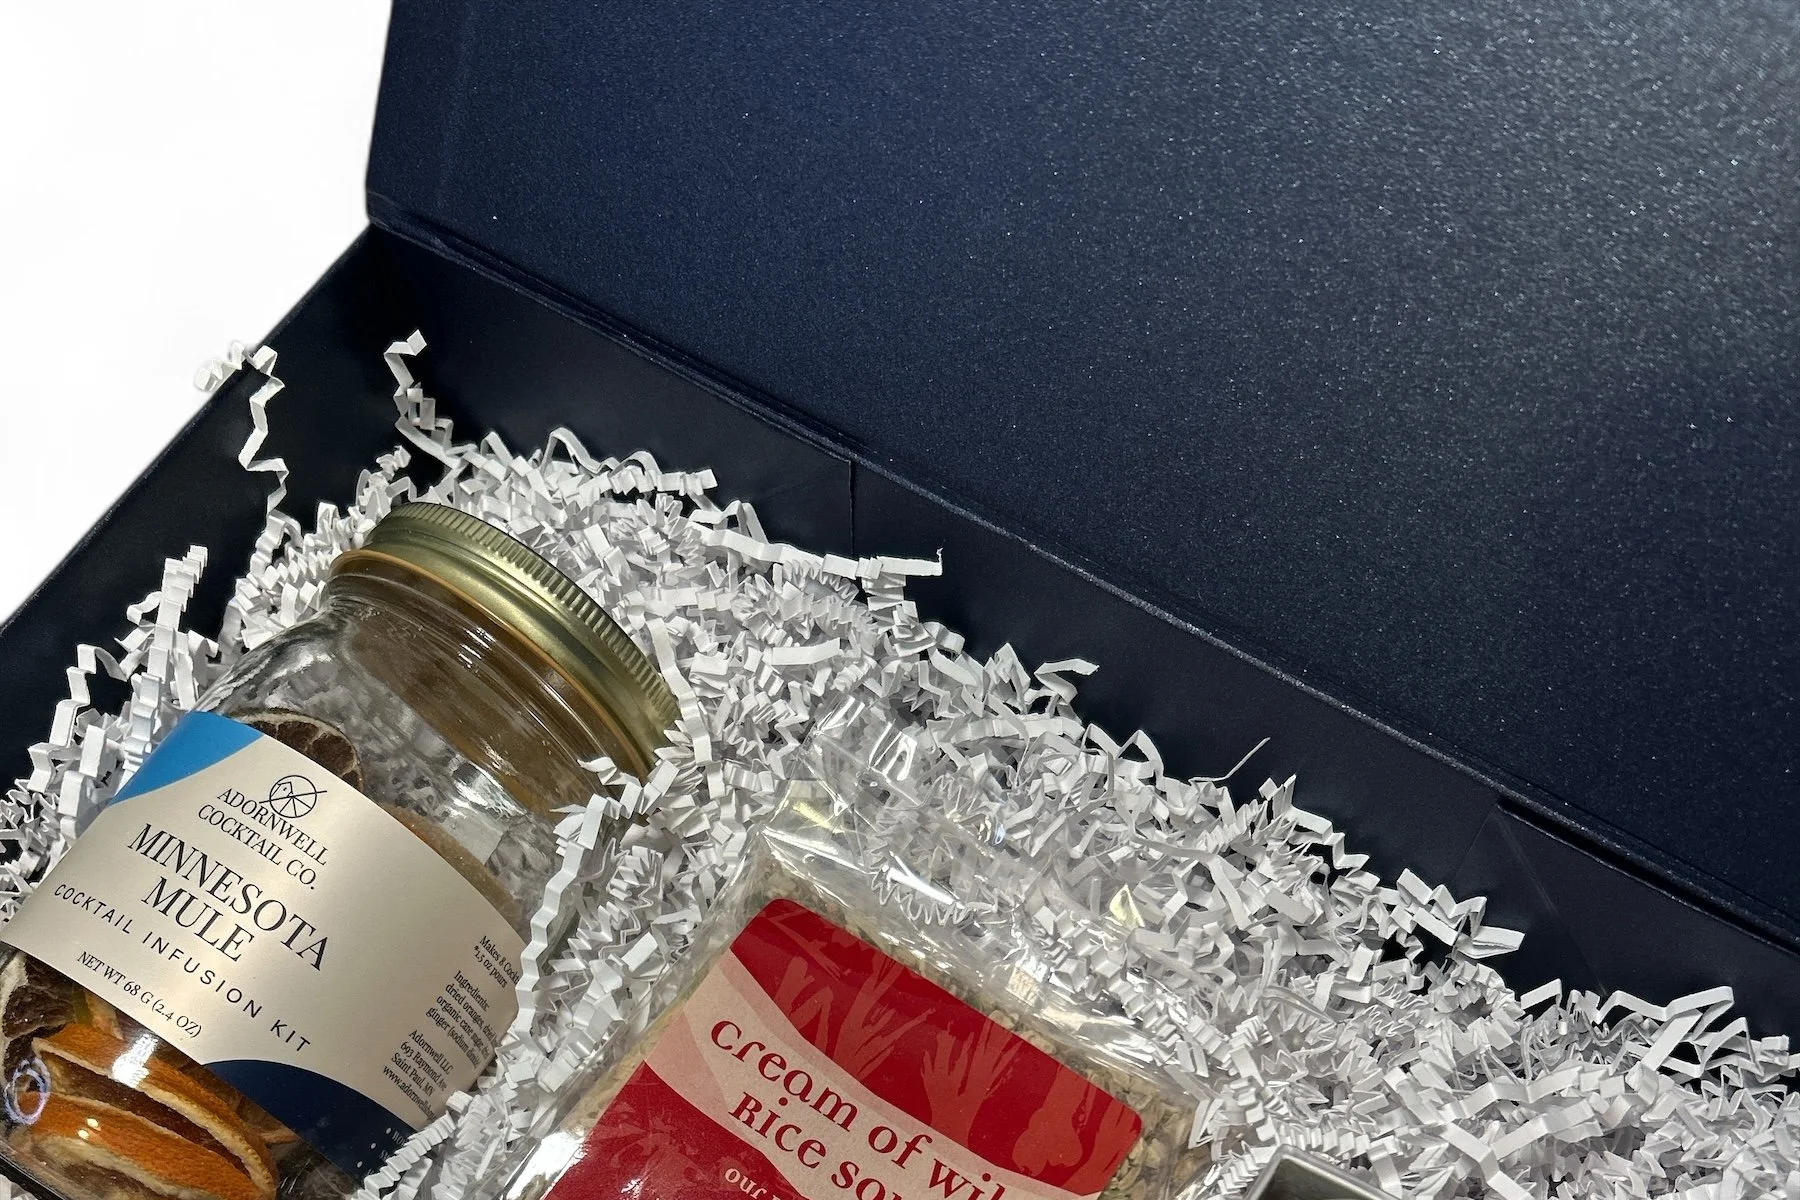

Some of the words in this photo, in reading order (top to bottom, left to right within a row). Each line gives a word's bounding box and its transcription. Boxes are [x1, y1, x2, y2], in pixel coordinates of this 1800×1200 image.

[198, 804, 283, 866] COCKTAIL
[286, 859, 317, 890] CO.
[217, 788, 328, 865] ADORNWELL
[127, 823, 328, 971] MINNESOTA
[141, 876, 255, 962] MULE
[54, 884, 131, 934] COCKTAIL
[142, 931, 262, 1019] INFUSION
[270, 1019, 311, 1052] KIT
[480, 935, 501, 961] Makes
[499, 956, 506, 966] 8
[77, 951, 105, 973] NET
[103, 966, 126, 985] WT
[123, 981, 140, 996] 68
[151, 998, 173, 1021] (2.4
[176, 1015, 202, 1038] OZ)
[445, 983, 467, 1005] dried
[489, 967, 508, 988] pours
[425, 1007, 450, 1031] ginger
[436, 995, 462, 1023] organic
[460, 1019, 473, 1036] cane
[391, 1052, 412, 1074] Saint
[408, 1068, 426, 1089] Paul,
[400, 1041, 414, 1058] 693
[412, 1051, 442, 1083] Raymond
[409, 1029, 444, 1064] Adornwell
[440, 1056, 454, 1075] LLC
[867, 1125, 933, 1170] of
[725, 1167, 768, 1200] our
